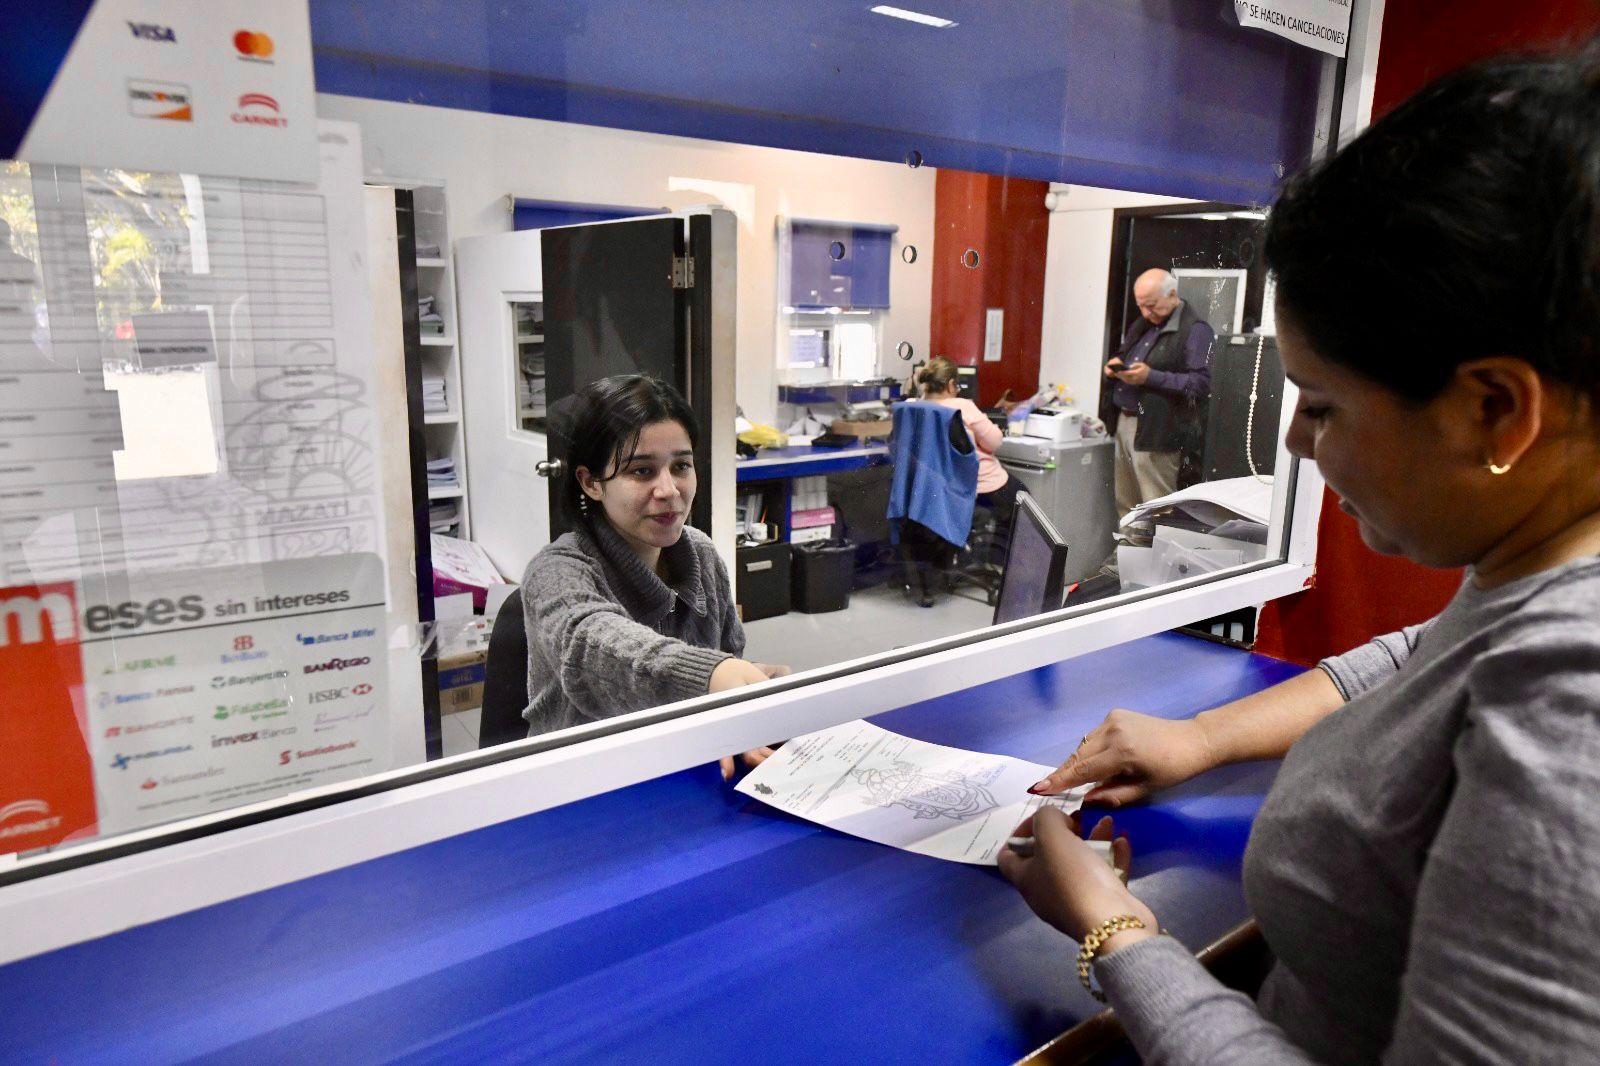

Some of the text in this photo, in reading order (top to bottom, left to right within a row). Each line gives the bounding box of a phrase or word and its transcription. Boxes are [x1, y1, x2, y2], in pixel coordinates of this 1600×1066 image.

[127, 21, 177, 43] VISA
[1249, 4, 1259, 19] SE
[1261, 8, 1286, 27] HACEN
[1287, 16, 1345, 45] CANCELACIONES
[230, 112, 288, 128] CARNET
[214, 599, 247, 618] sin
[254, 588, 351, 613] intereses
[316, 633, 349, 644] Banca
[308, 686, 350, 705] HSBC
[211, 726, 298, 748] invex Banco
